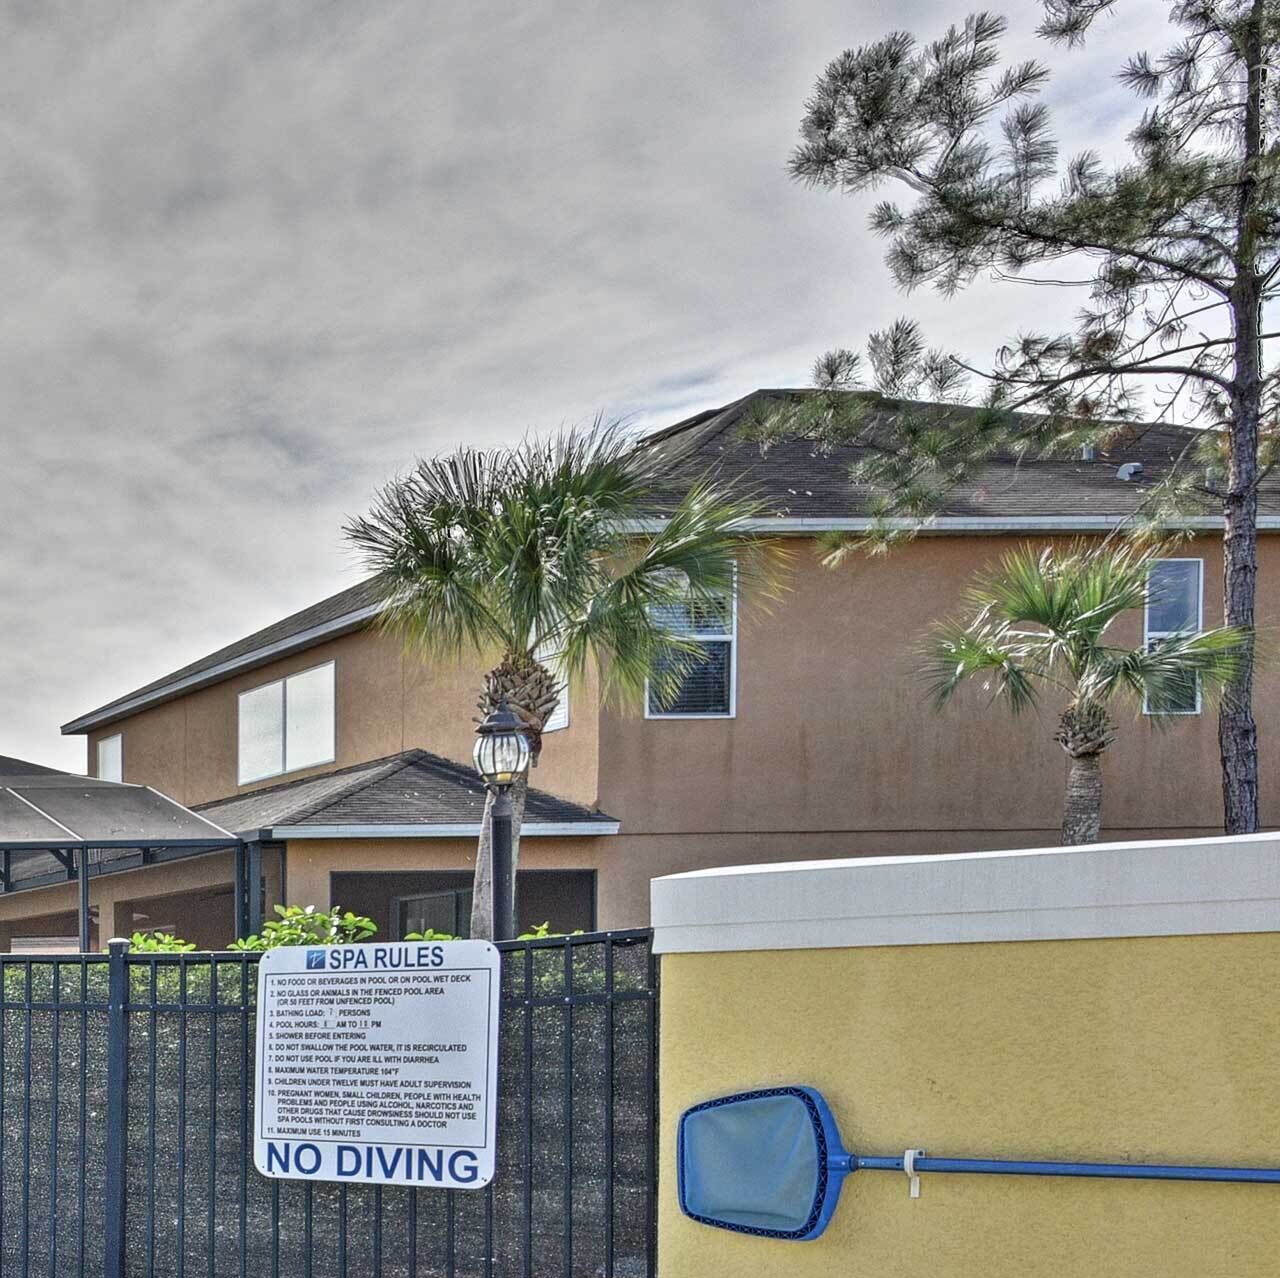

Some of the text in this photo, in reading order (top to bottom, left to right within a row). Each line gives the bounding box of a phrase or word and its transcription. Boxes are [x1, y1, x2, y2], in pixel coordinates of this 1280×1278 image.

[330, 946, 444, 969] SPA RULES
[318, 978, 358, 986] BEVERAGES
[321, 989, 350, 997] ANIMALS
[336, 997, 372, 1005] UNFENCED
[374, 998, 394, 1006] POOL)
[367, 1110, 414, 1118] DROWSINESS
[366, 1118, 409, 1126] CONSULTING
[267, 1142, 478, 1183] NO DIVING
